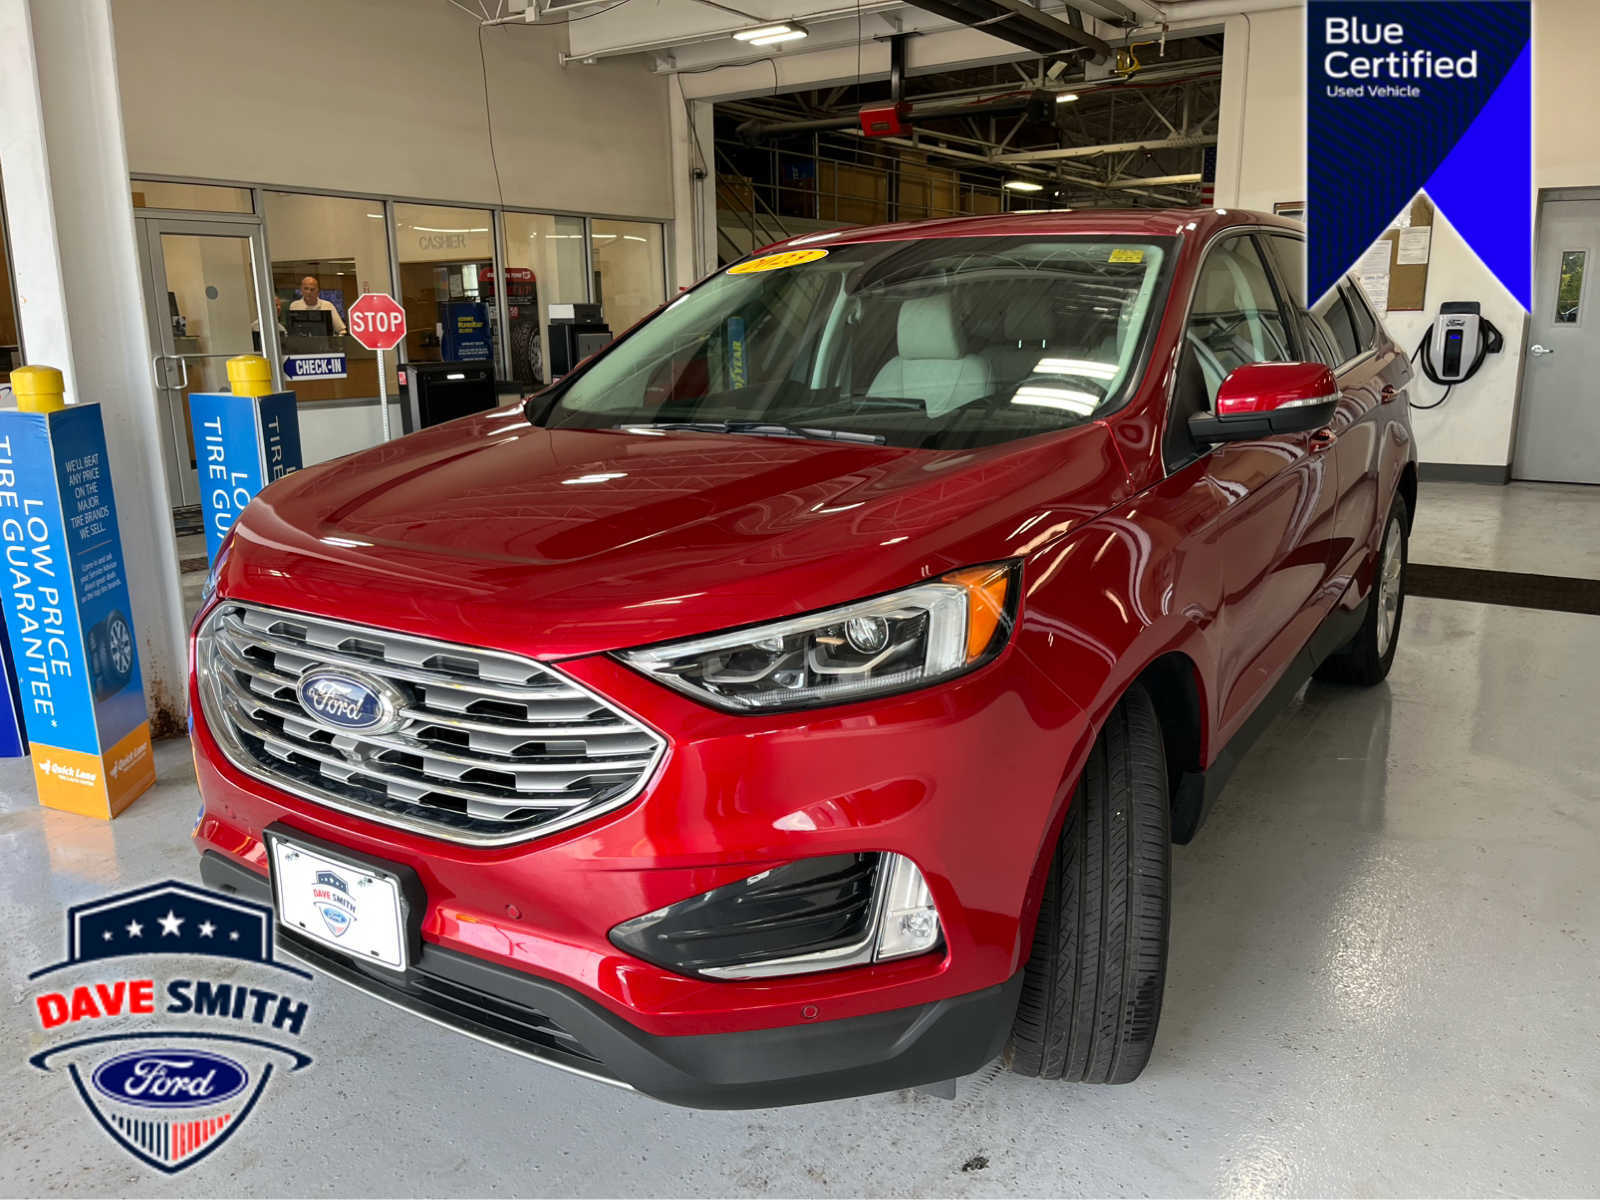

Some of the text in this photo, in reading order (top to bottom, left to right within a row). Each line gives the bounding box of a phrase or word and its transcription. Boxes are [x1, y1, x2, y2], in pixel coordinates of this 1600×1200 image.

[418, 234, 467, 250] CASHIER
[352, 312, 402, 333] STOP
[295, 356, 342, 376] CHECK-IN
[268, 415, 284, 480] TIRE
[84, 453, 99, 468] BEAT
[0, 435, 19, 508] TIRE
[69, 467, 100, 488] ANY PRICE
[203, 416, 232, 539] TIRE GU
[75, 482, 99, 499] ON THE
[77, 495, 99, 512] MAJOR
[70, 505, 110, 529] TIRE BRANDS
[80, 526, 90, 540] WE
[23, 499, 72, 678] LOW PRICE
[311, 681, 362, 720] Ford
[52, 763, 75, 777] Quick
[75, 768, 97, 781] Lane
[313, 888, 356, 913] DAVE SMITH
